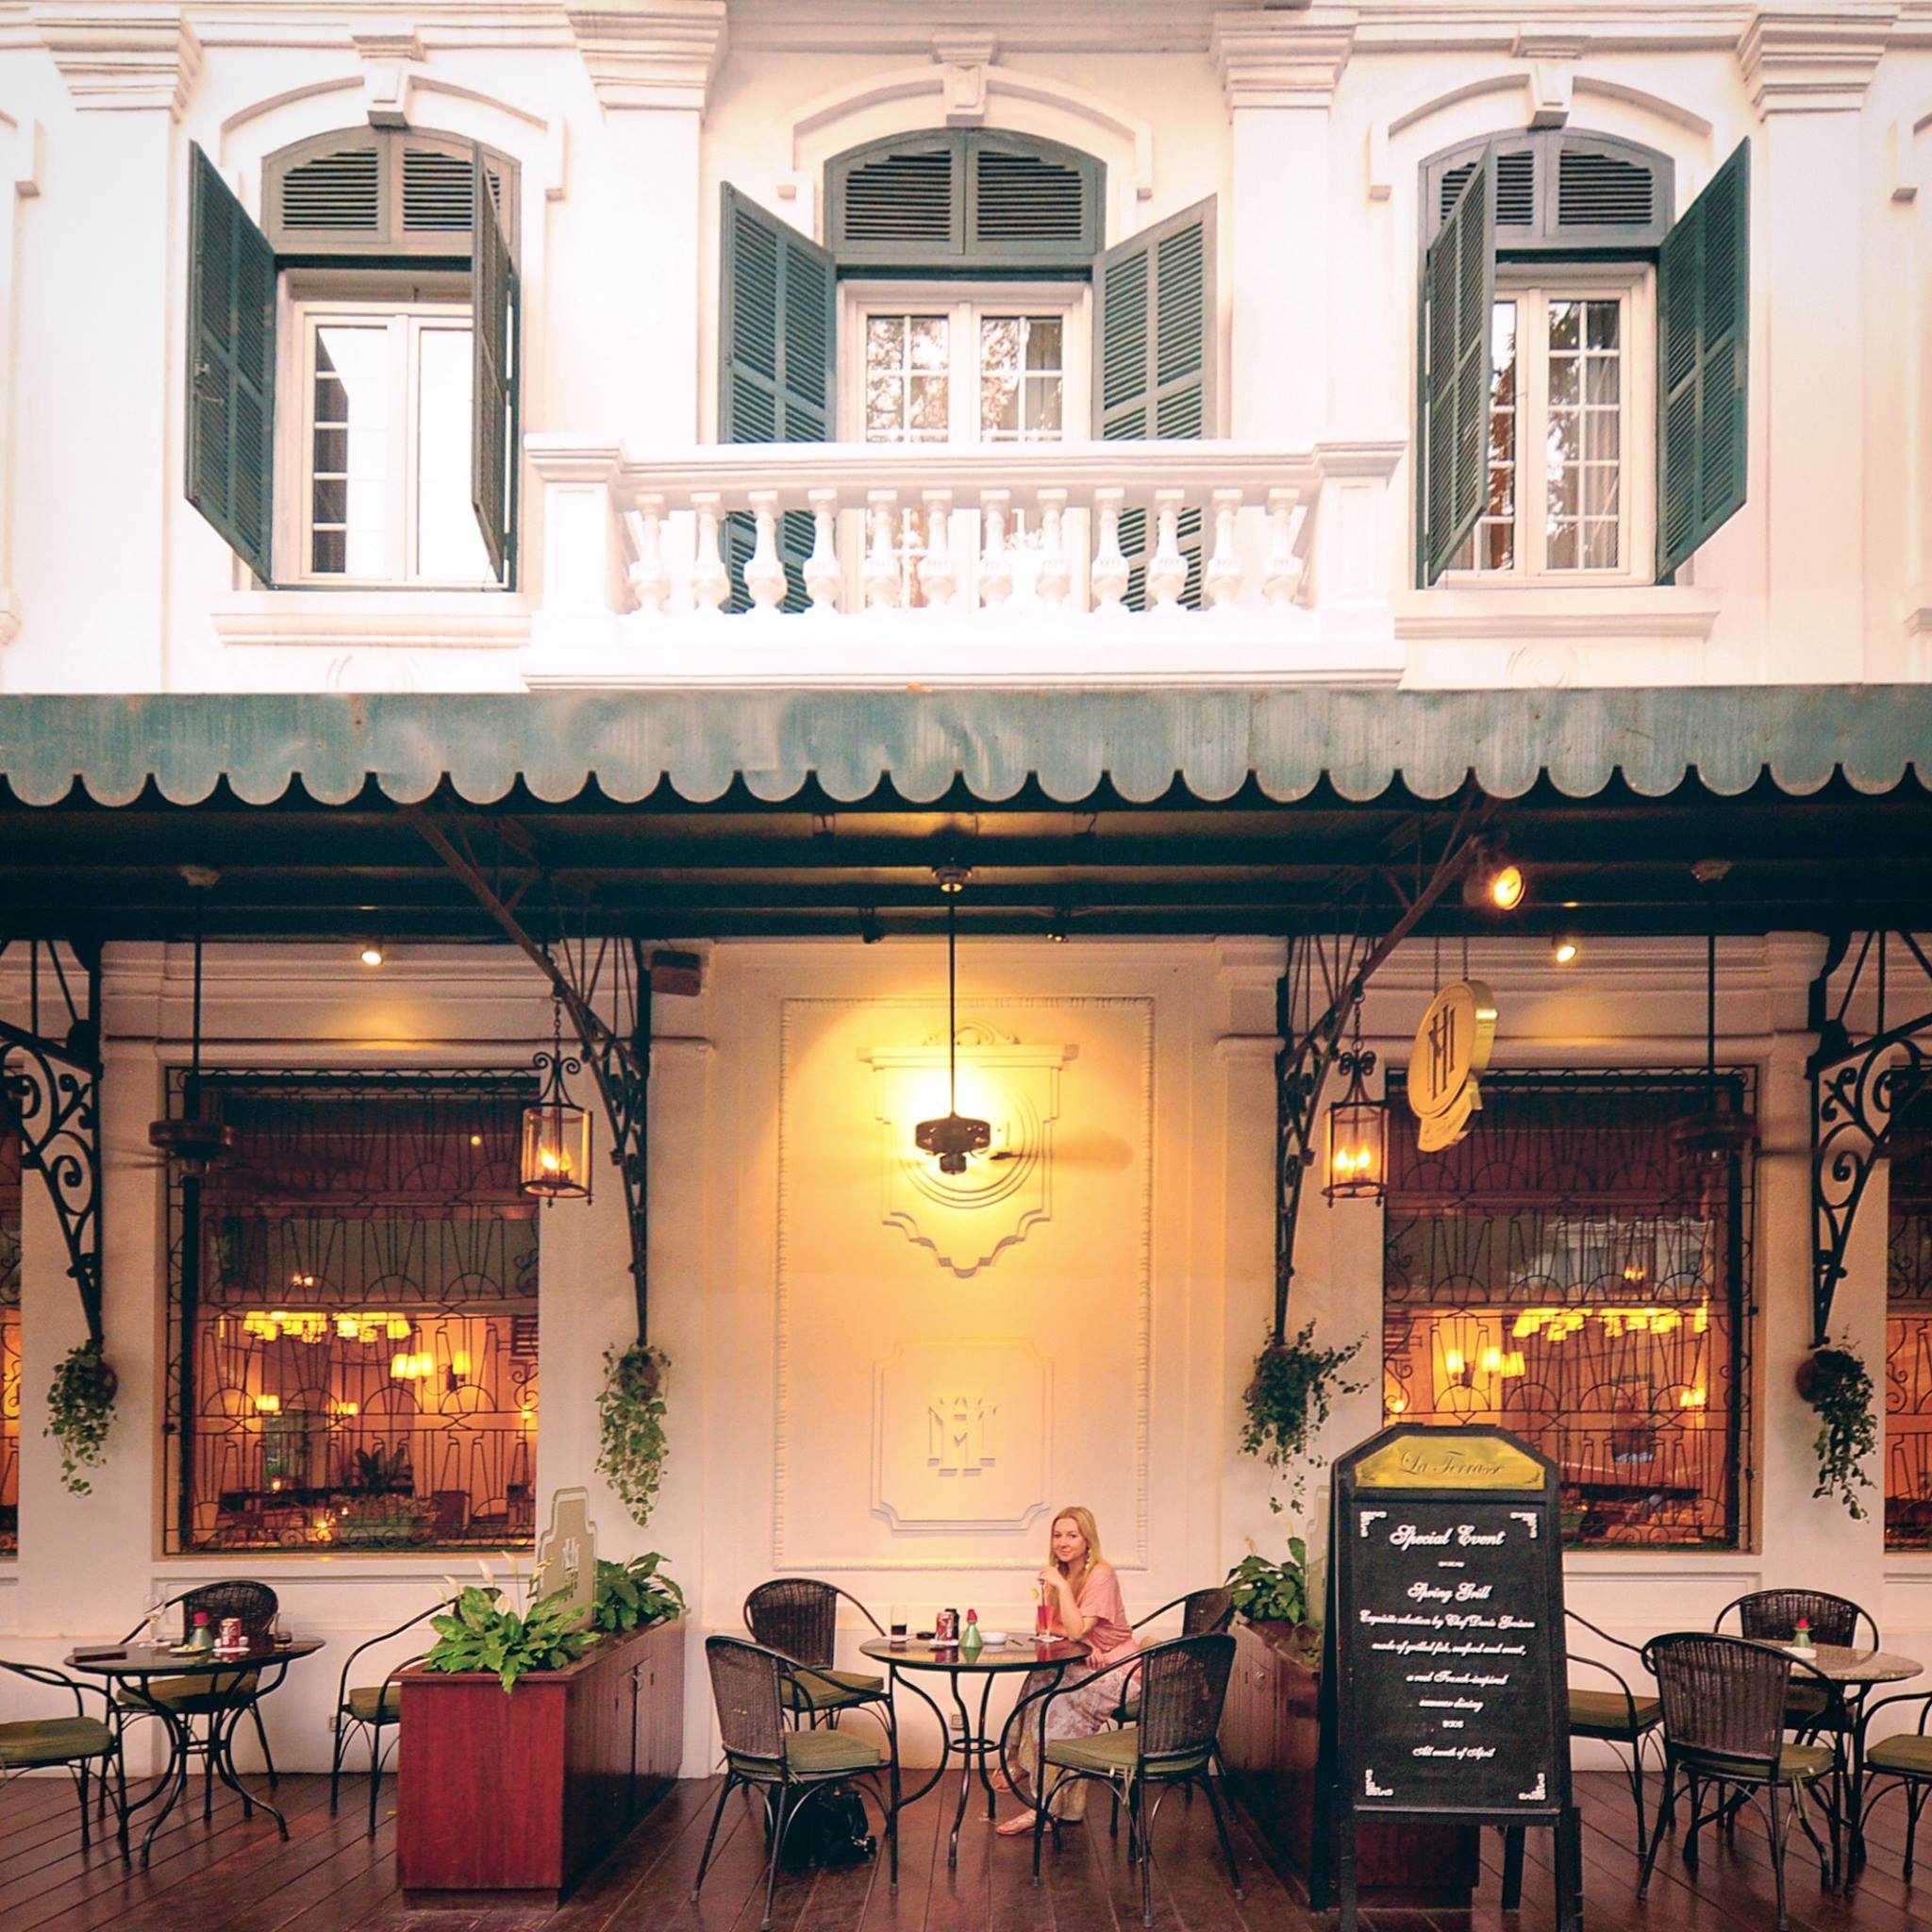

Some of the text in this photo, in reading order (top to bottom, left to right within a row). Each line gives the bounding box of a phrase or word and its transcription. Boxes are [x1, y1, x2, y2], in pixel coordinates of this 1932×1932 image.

[1390, 1524, 1507, 1551] Special Event
[1407, 1582, 1492, 1604] Spring Grill
